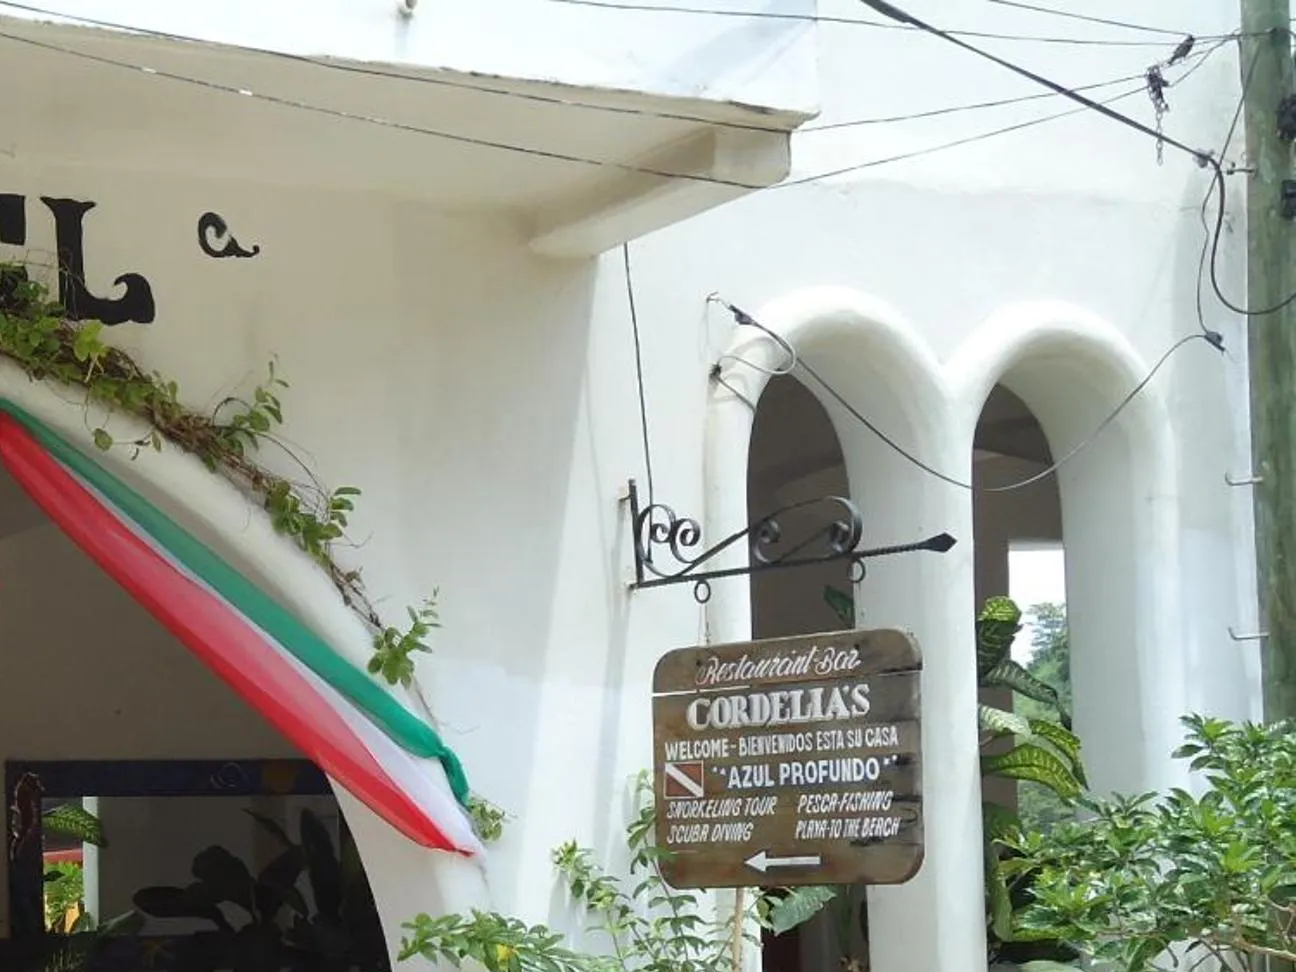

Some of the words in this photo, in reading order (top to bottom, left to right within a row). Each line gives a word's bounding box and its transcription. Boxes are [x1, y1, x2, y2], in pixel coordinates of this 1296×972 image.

[687, 684, 870, 730] CORDELIA'S
[816, 731, 844, 751] ESTA
[846, 728, 863, 748] SU
[865, 726, 898, 746] CASA
[744, 796, 778, 816] TOUR
[666, 826, 708, 844] SCUBA
[711, 822, 754, 843] DIVING
[861, 816, 901, 837] BEACH
